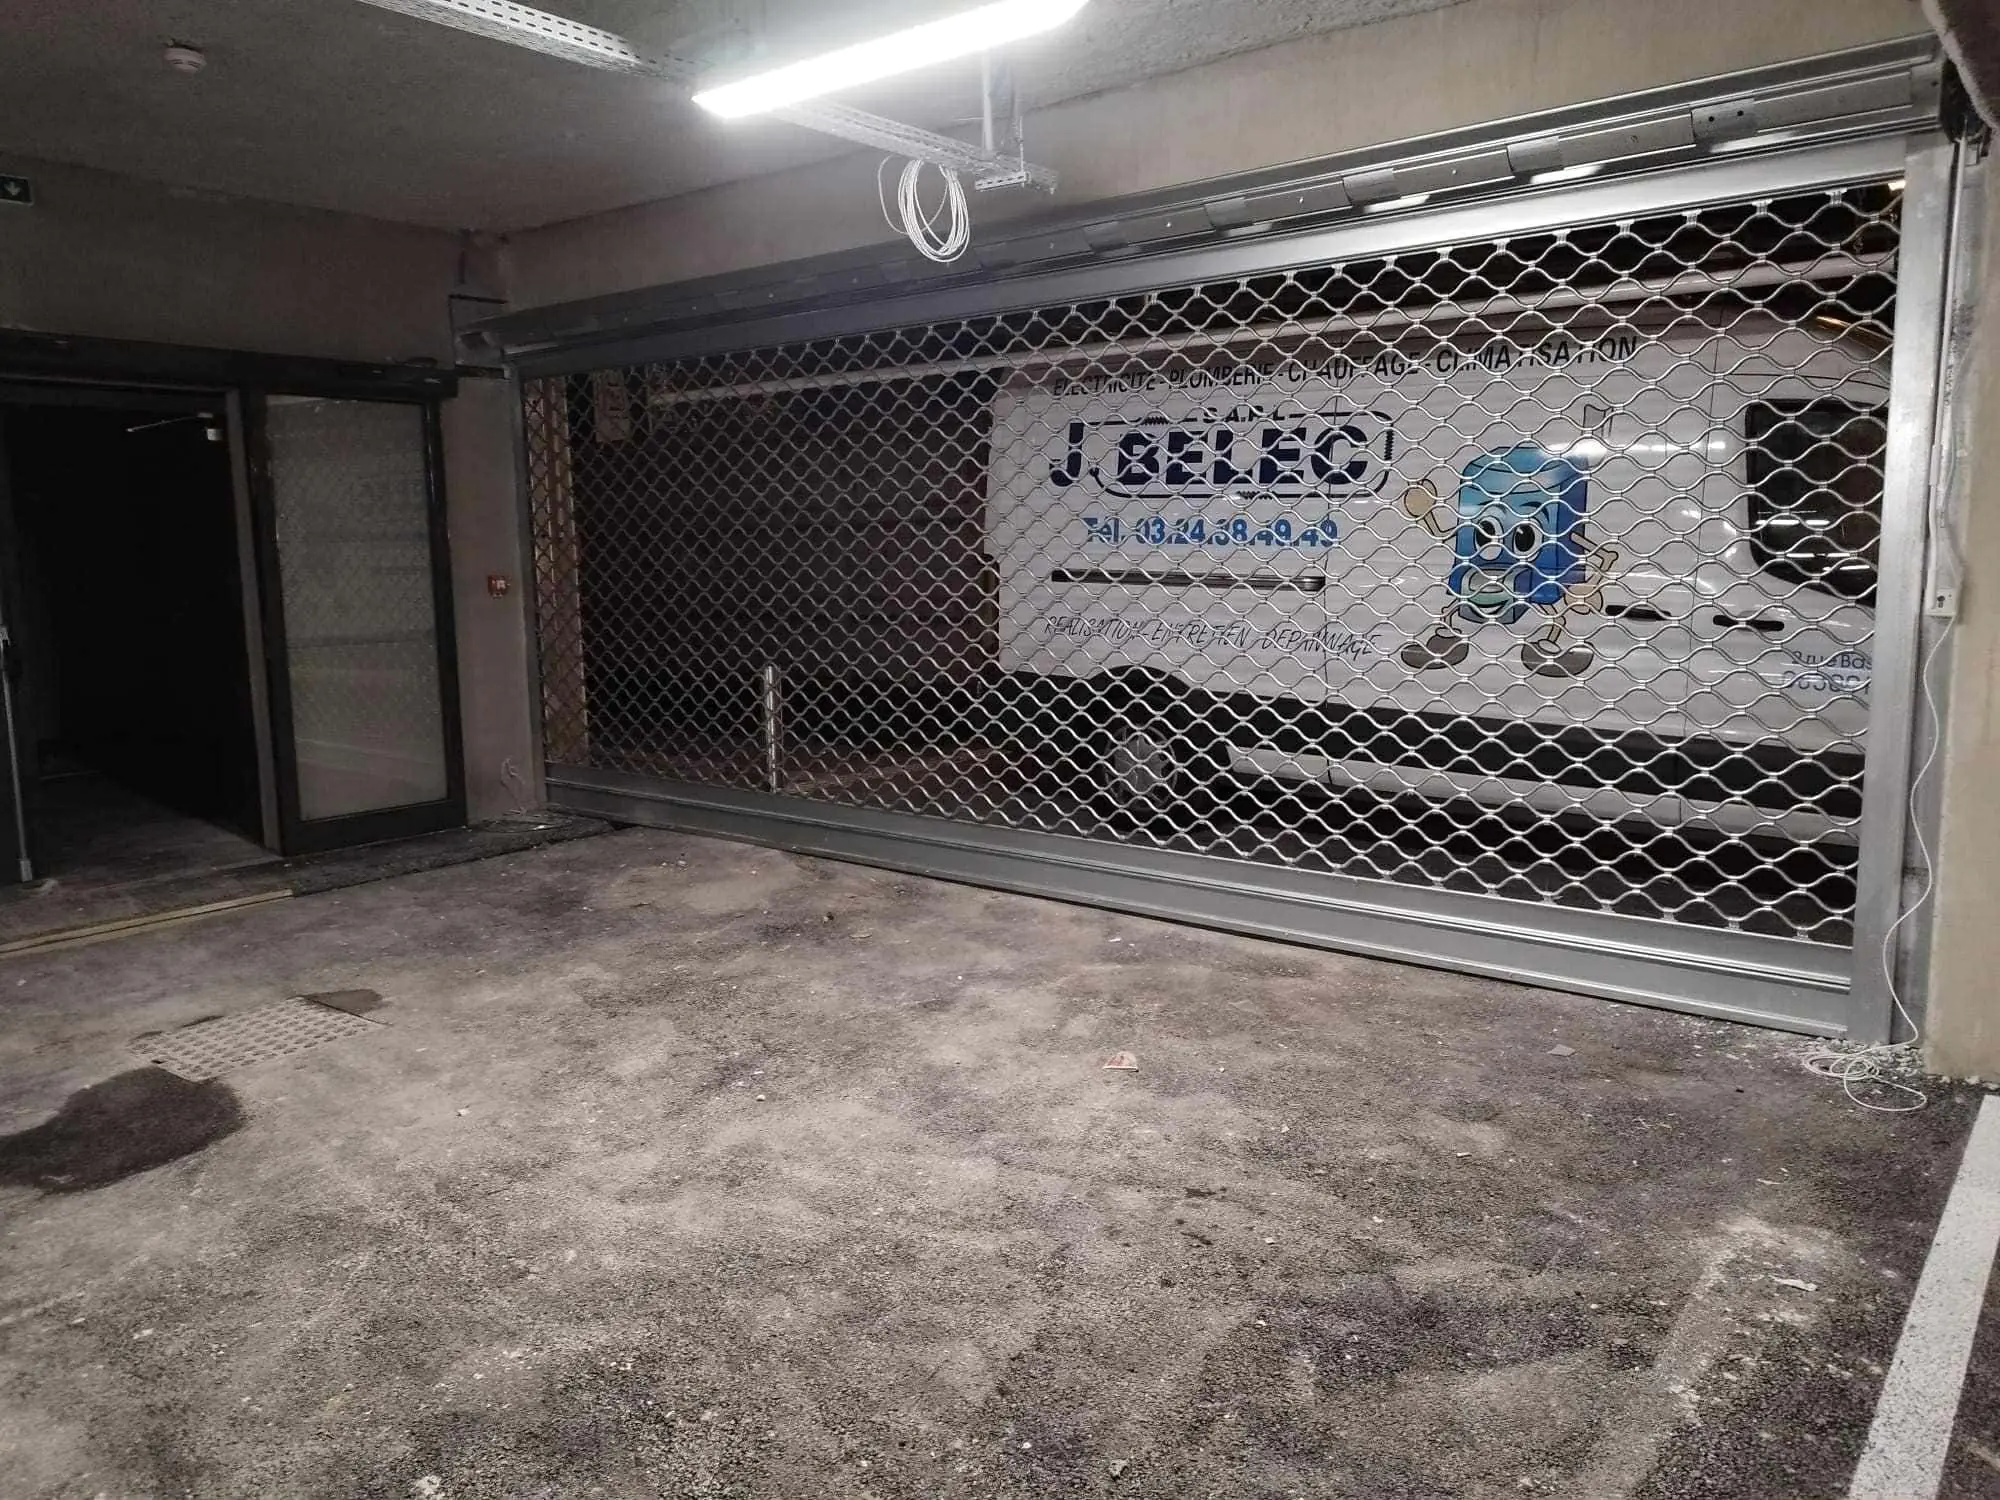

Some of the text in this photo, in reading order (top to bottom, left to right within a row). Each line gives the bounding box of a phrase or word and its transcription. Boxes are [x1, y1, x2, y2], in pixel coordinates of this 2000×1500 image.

[1168, 363, 1274, 390] PLOMBERIE
[1288, 351, 1420, 383] CHAUFFAGE
[1436, 336, 1637, 372] CLIMATISATION
[1117, 425, 1367, 484] BELEC
[1135, 517, 1338, 547] 03.24.38.49.49
